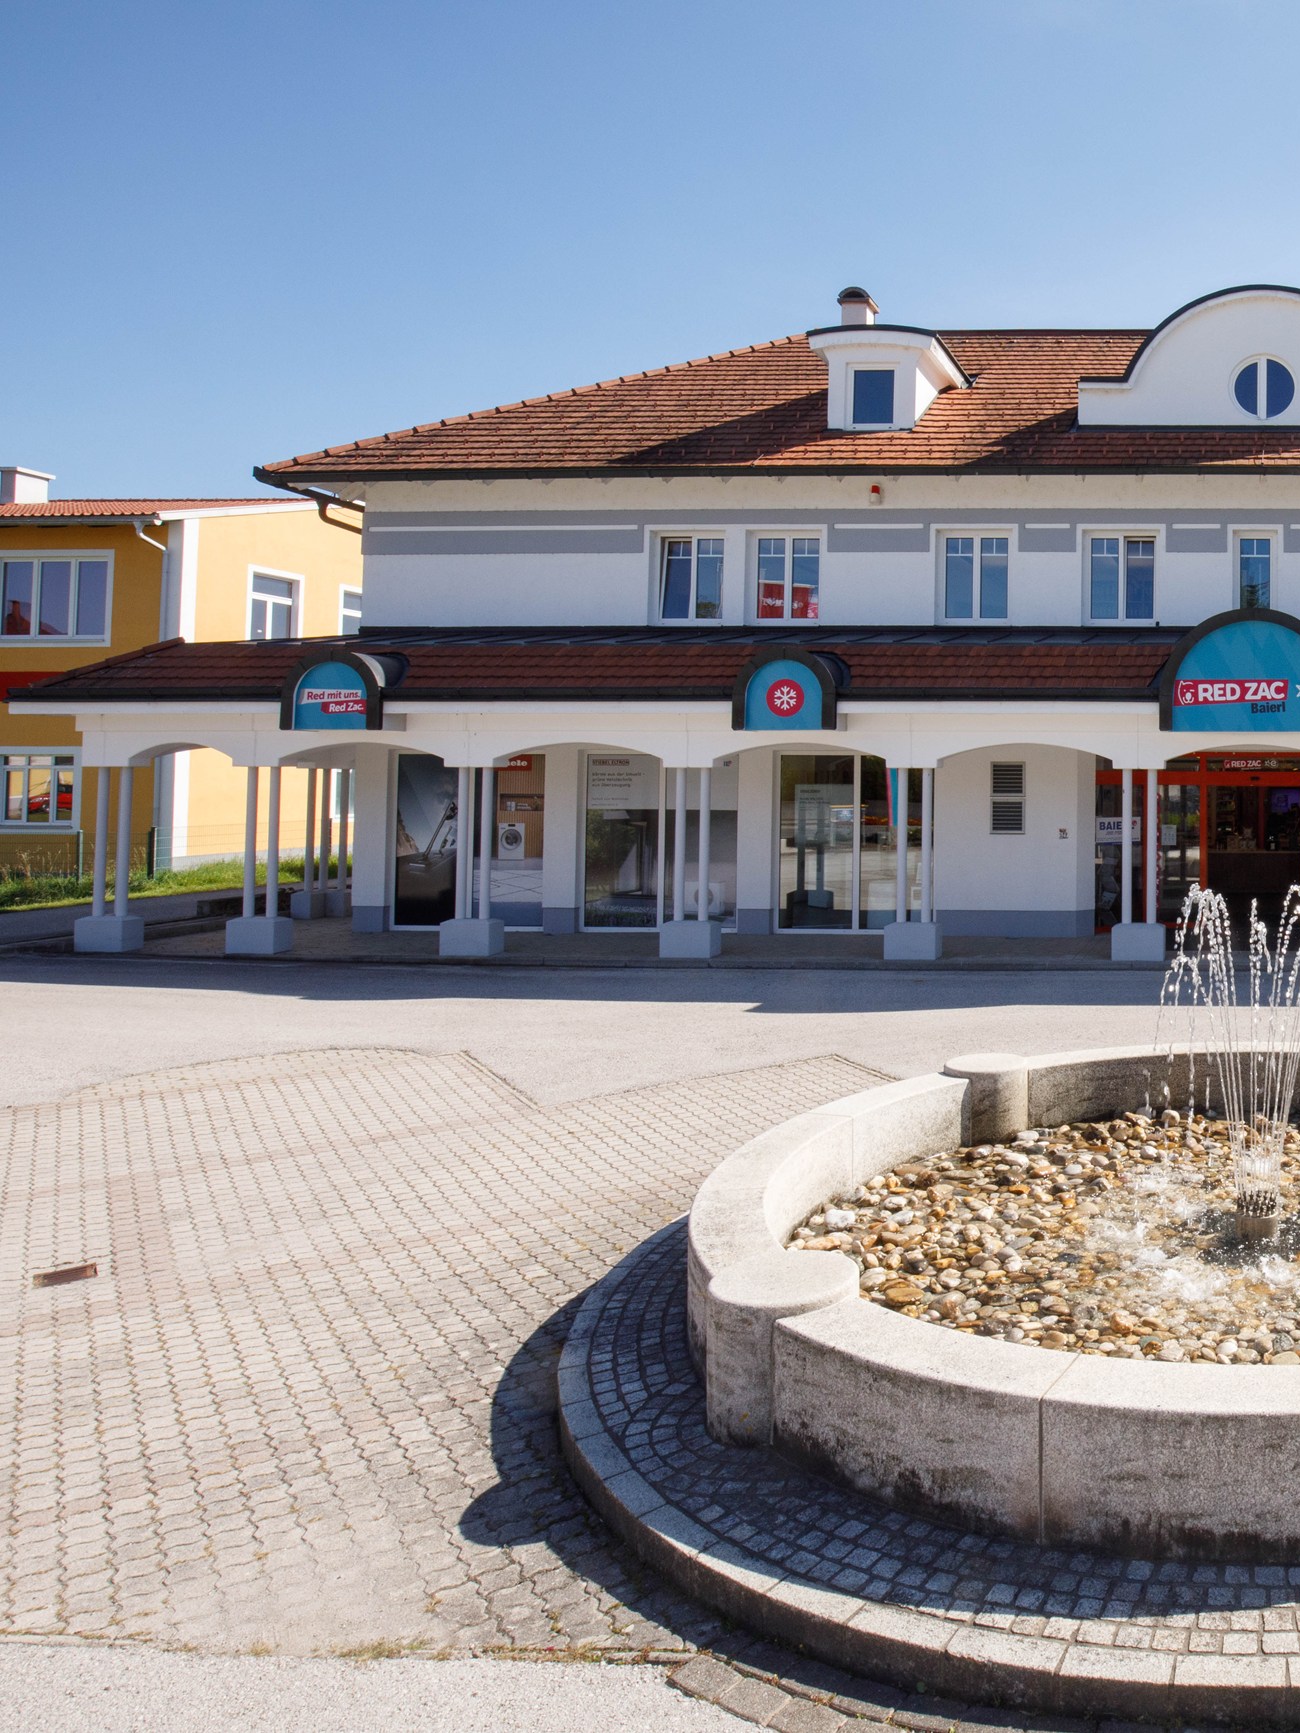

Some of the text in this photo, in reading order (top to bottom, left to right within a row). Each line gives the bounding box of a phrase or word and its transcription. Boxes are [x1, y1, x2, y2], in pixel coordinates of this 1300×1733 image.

[307, 691, 361, 700] Red mit uns.
[1197, 681, 1285, 702] RED ZAC
[329, 702, 364, 712] Red Zac.
[1250, 702, 1286, 714] Baierl
[1231, 760, 1262, 768] RED ZAC
[1099, 821, 1124, 831] BAIE
